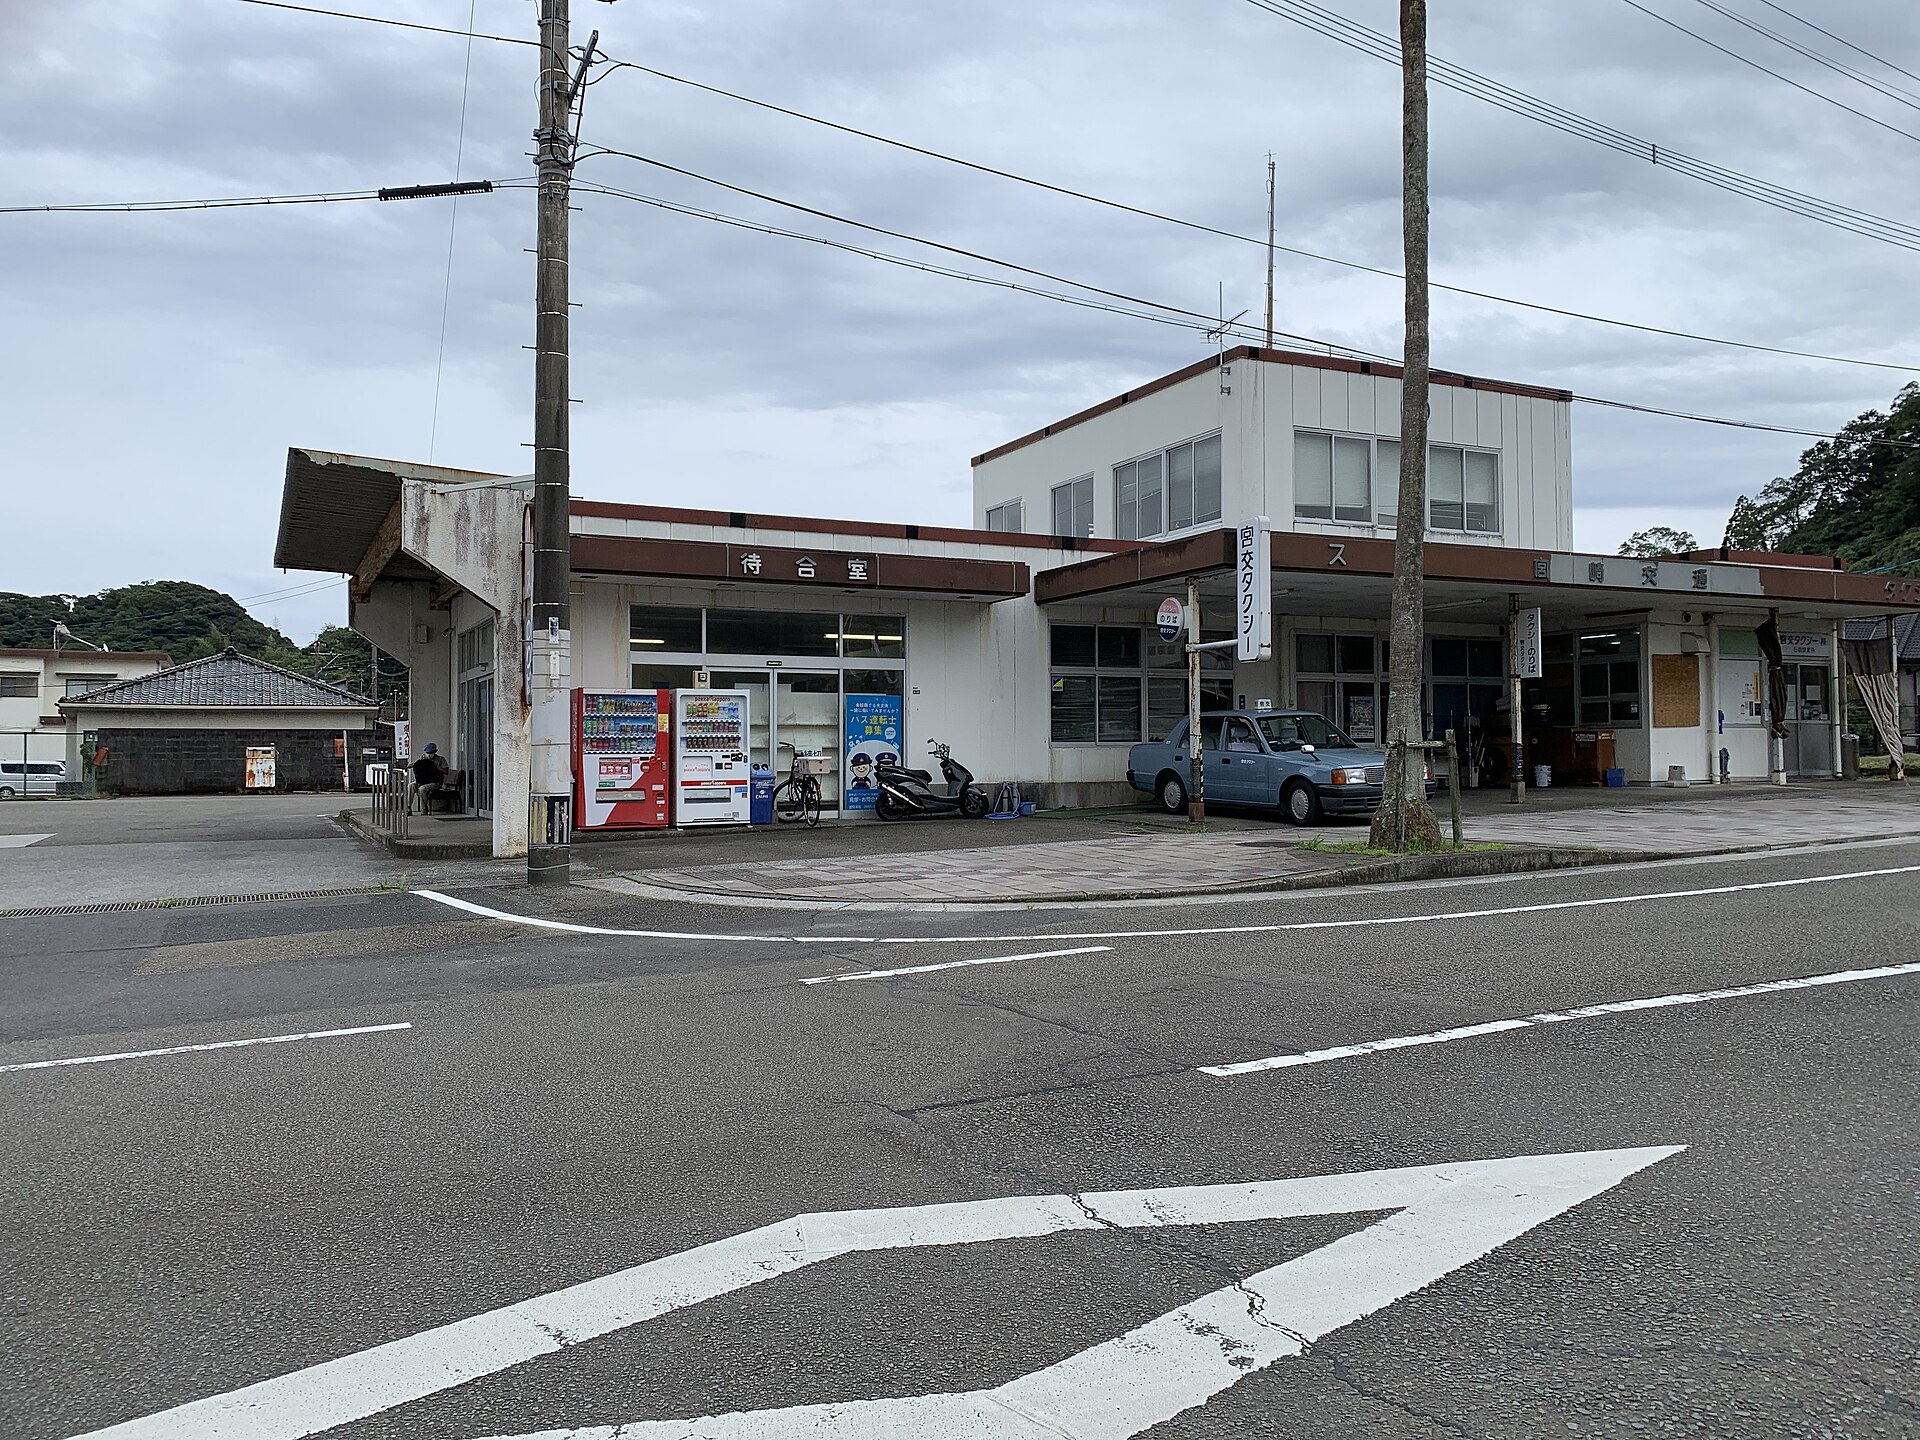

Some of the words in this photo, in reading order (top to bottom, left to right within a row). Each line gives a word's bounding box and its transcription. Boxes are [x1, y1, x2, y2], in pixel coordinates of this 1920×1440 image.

[740, 552, 868, 580] 待合室
[1240, 525, 1254, 653] 宮交タクシー
[1160, 615, 1178, 624] のりば
[1527, 613, 1537, 674] タクシーのりば
[864, 725, 882, 736] 募集
